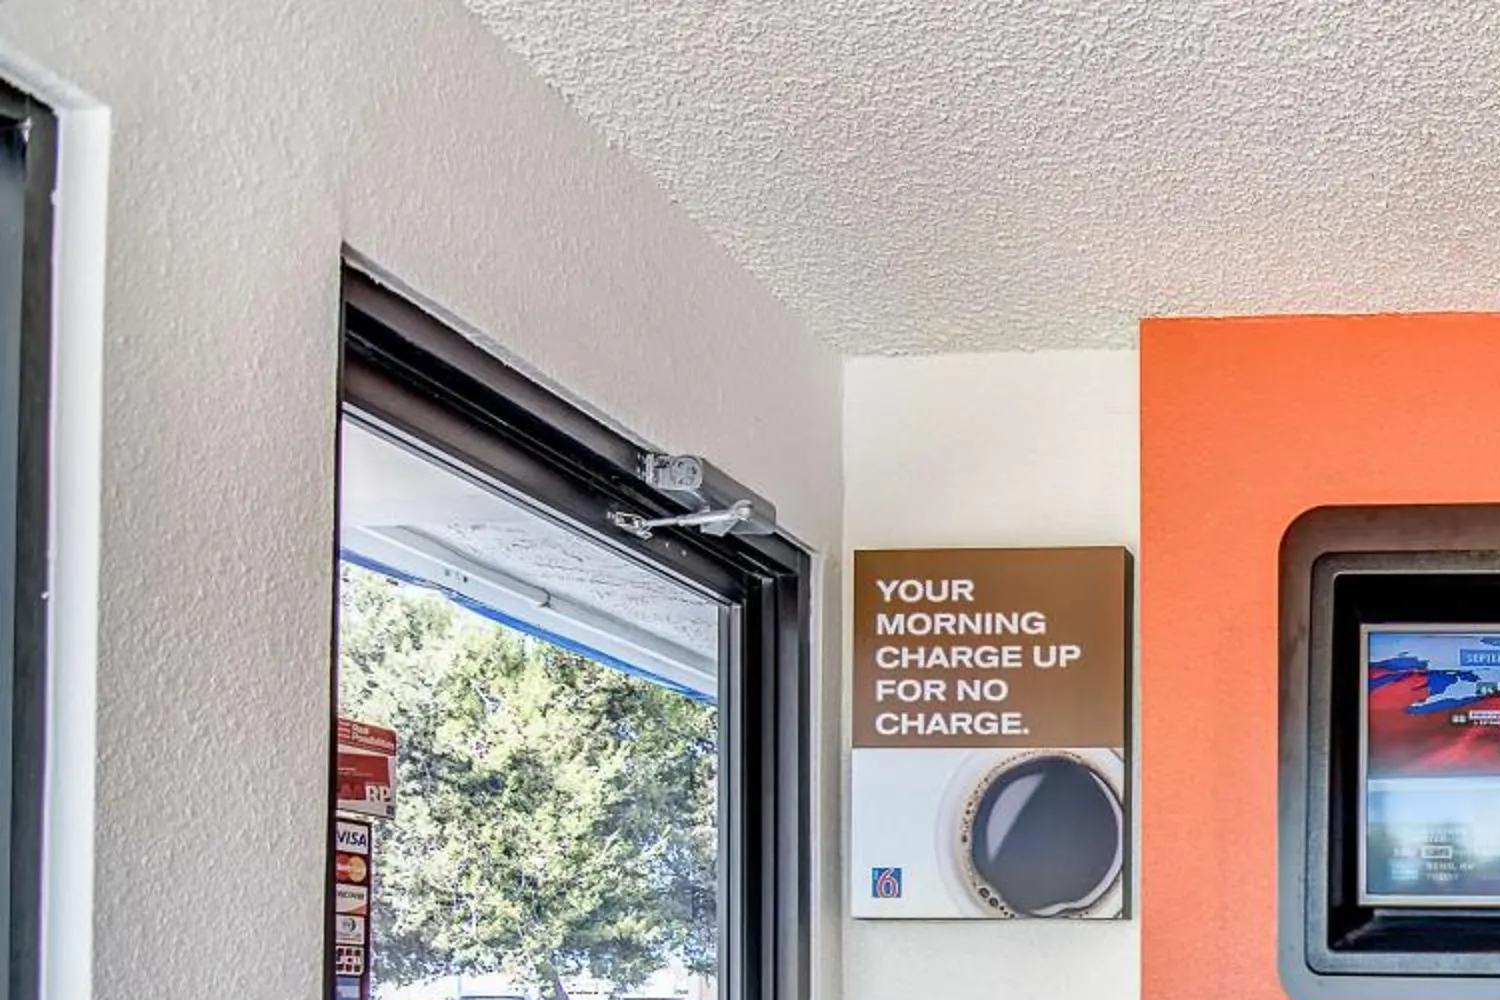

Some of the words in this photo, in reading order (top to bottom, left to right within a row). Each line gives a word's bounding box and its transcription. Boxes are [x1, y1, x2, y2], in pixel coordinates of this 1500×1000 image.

[876, 579, 975, 603] YOUR
[876, 611, 1046, 636] MORNING
[875, 645, 1022, 669] CHARGE
[1033, 644, 1081, 668] UP
[876, 679, 947, 702] FOR
[957, 679, 1009, 702] NO
[875, 711, 1029, 735] CHARGE.
[337, 831, 367, 847] VISA
